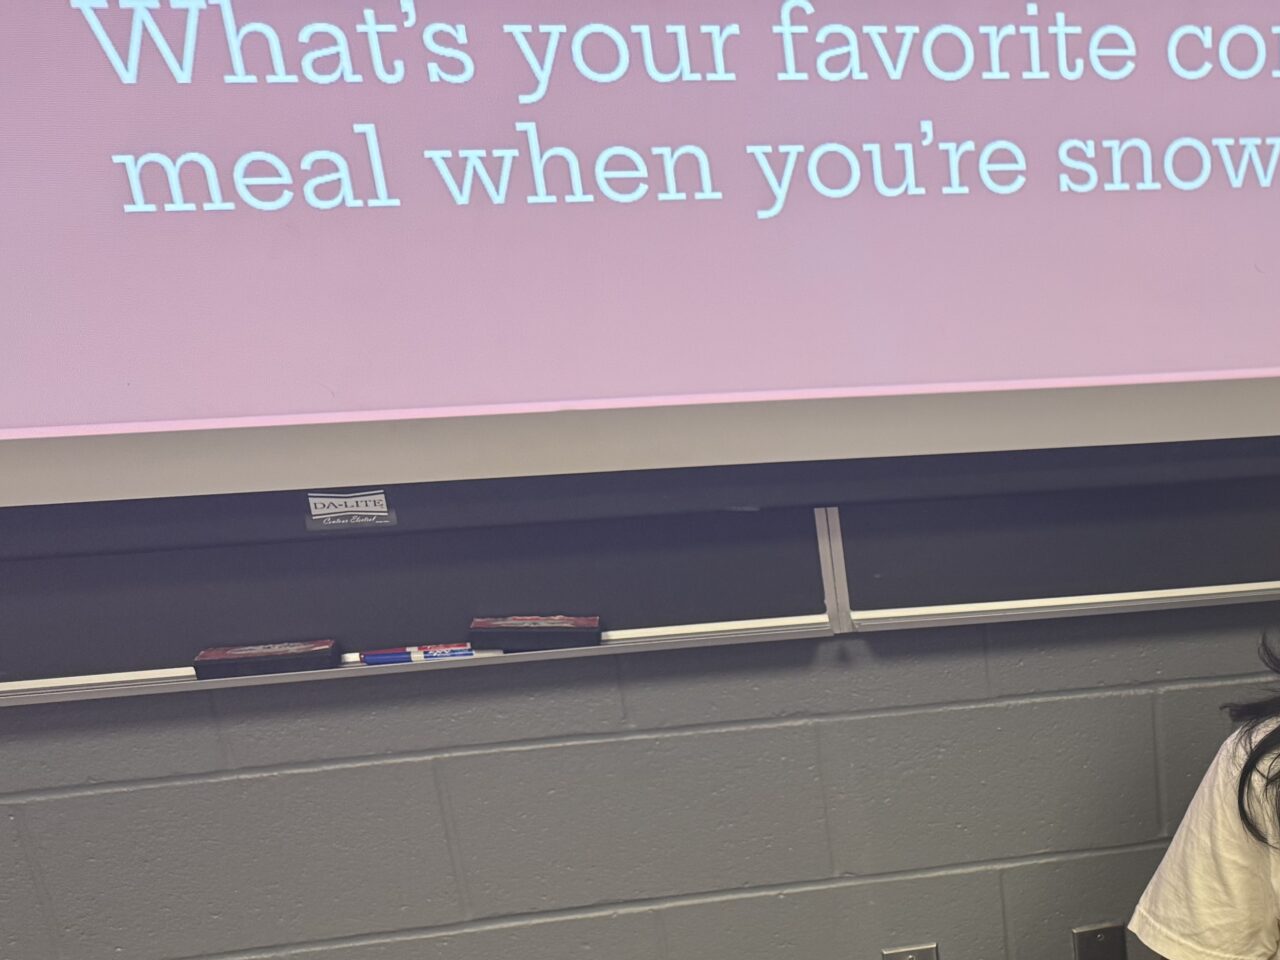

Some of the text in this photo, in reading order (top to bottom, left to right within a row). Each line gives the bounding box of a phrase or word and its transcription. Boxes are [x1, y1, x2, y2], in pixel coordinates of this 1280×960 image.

[70, 0, 476, 86] What's
[503, 24, 741, 104] your
[772, 0, 1137, 83] favorite
[112, 124, 401, 213] meal
[424, 121, 723, 206] when
[746, 120, 1028, 219] you're
[313, 498, 385, 510] DA-LITE
